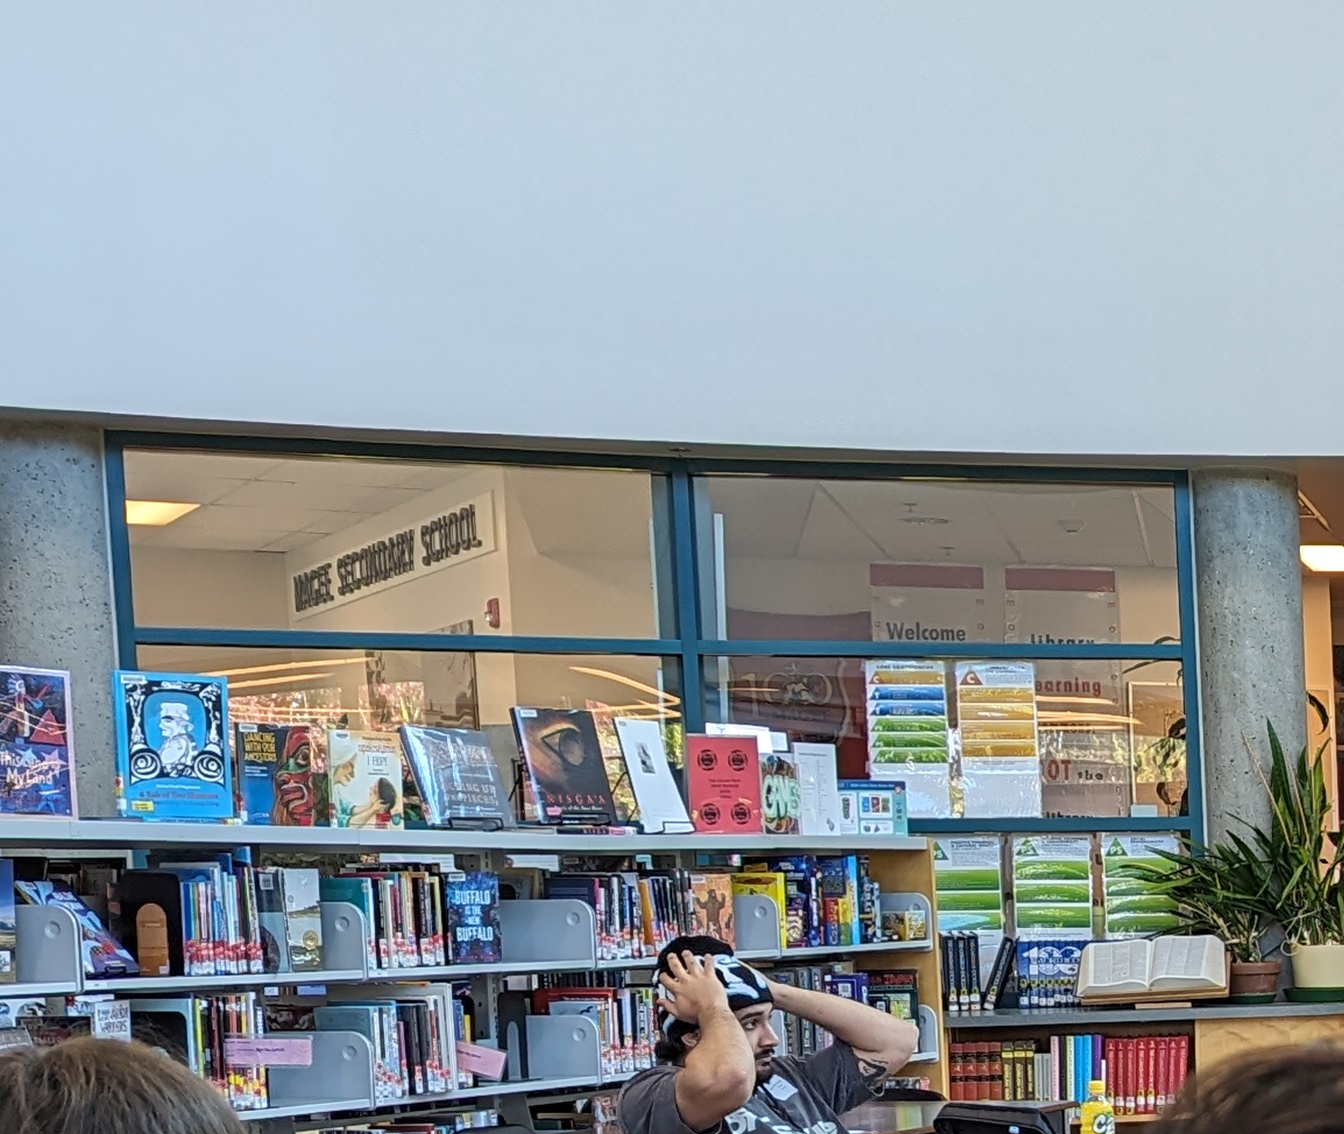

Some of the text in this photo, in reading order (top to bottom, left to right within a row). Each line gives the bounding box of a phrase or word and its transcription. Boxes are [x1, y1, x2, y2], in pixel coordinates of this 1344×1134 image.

[337, 529, 415, 596] SECONDARY
[421, 504, 482, 566] SCHOOL
[886, 622, 967, 642] Welcome
[1036, 677, 1102, 697] earning
[455, 890, 491, 905] BUFFALO
[456, 926, 494, 942] BUFFALO
